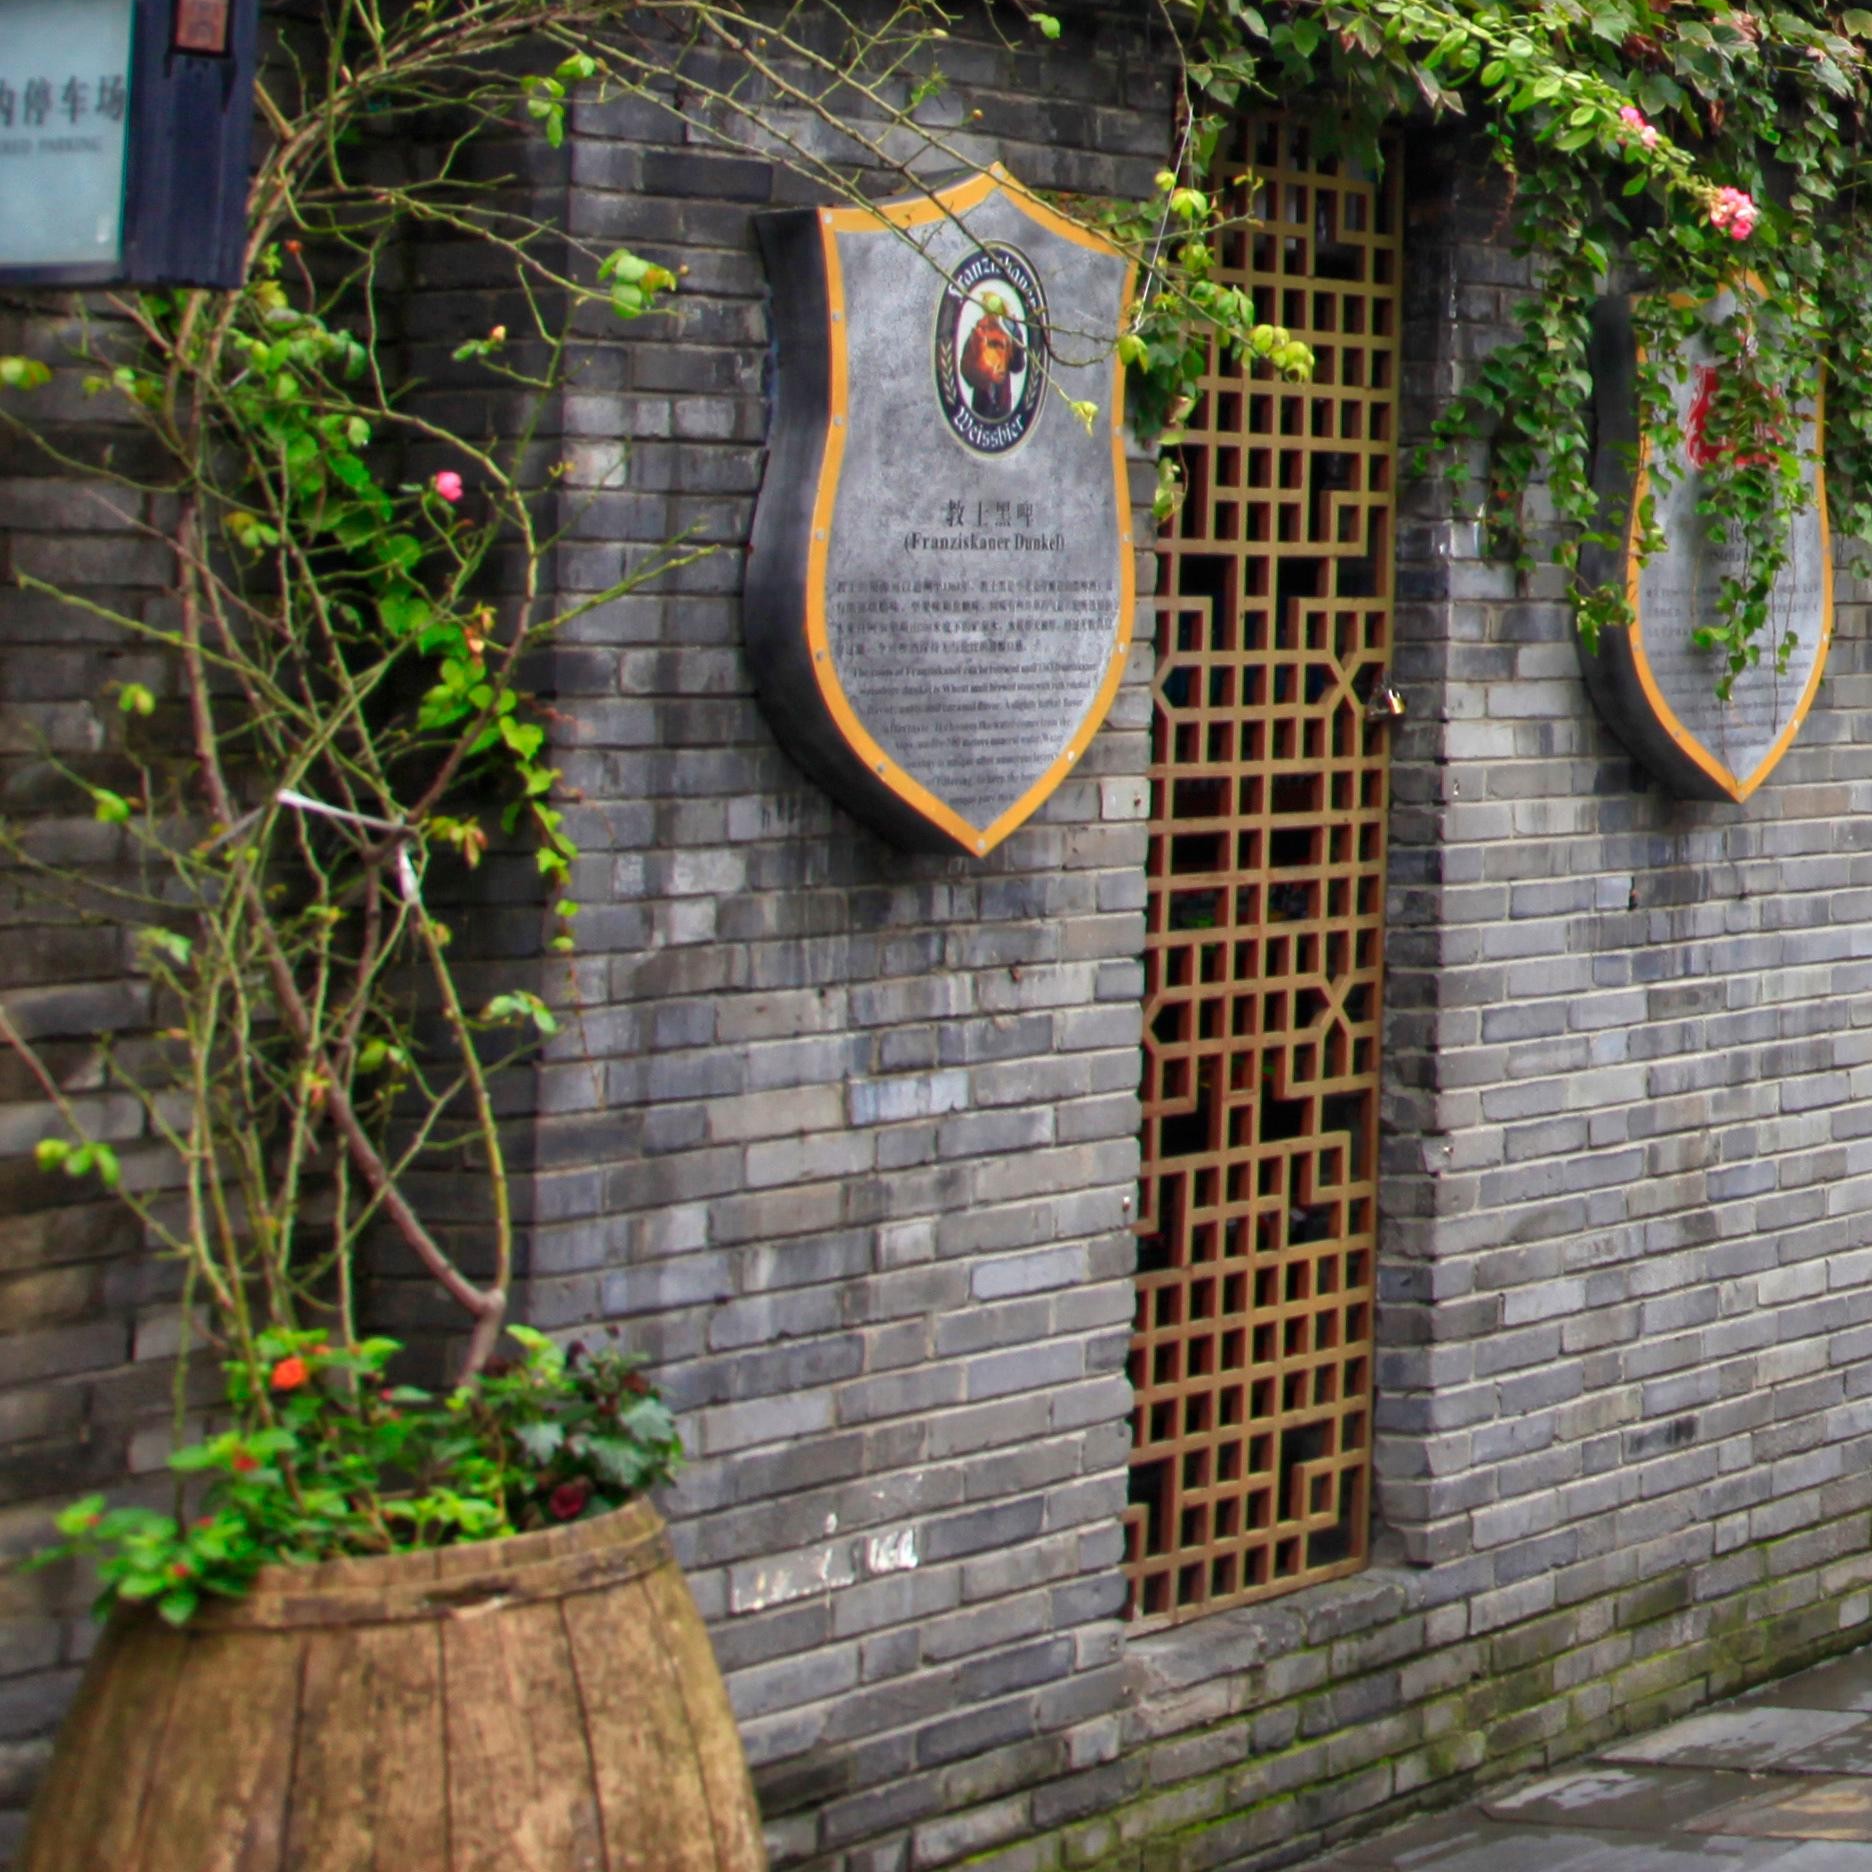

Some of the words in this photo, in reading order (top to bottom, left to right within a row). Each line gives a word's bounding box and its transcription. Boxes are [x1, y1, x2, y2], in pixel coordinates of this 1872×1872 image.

[953, 407, 1026, 449] Weissbier
[946, 499, 1034, 528] 教士黑啤
[903, 532, 1010, 553] (Franziskaner
[1014, 532, 1066, 552] Dunkel)
